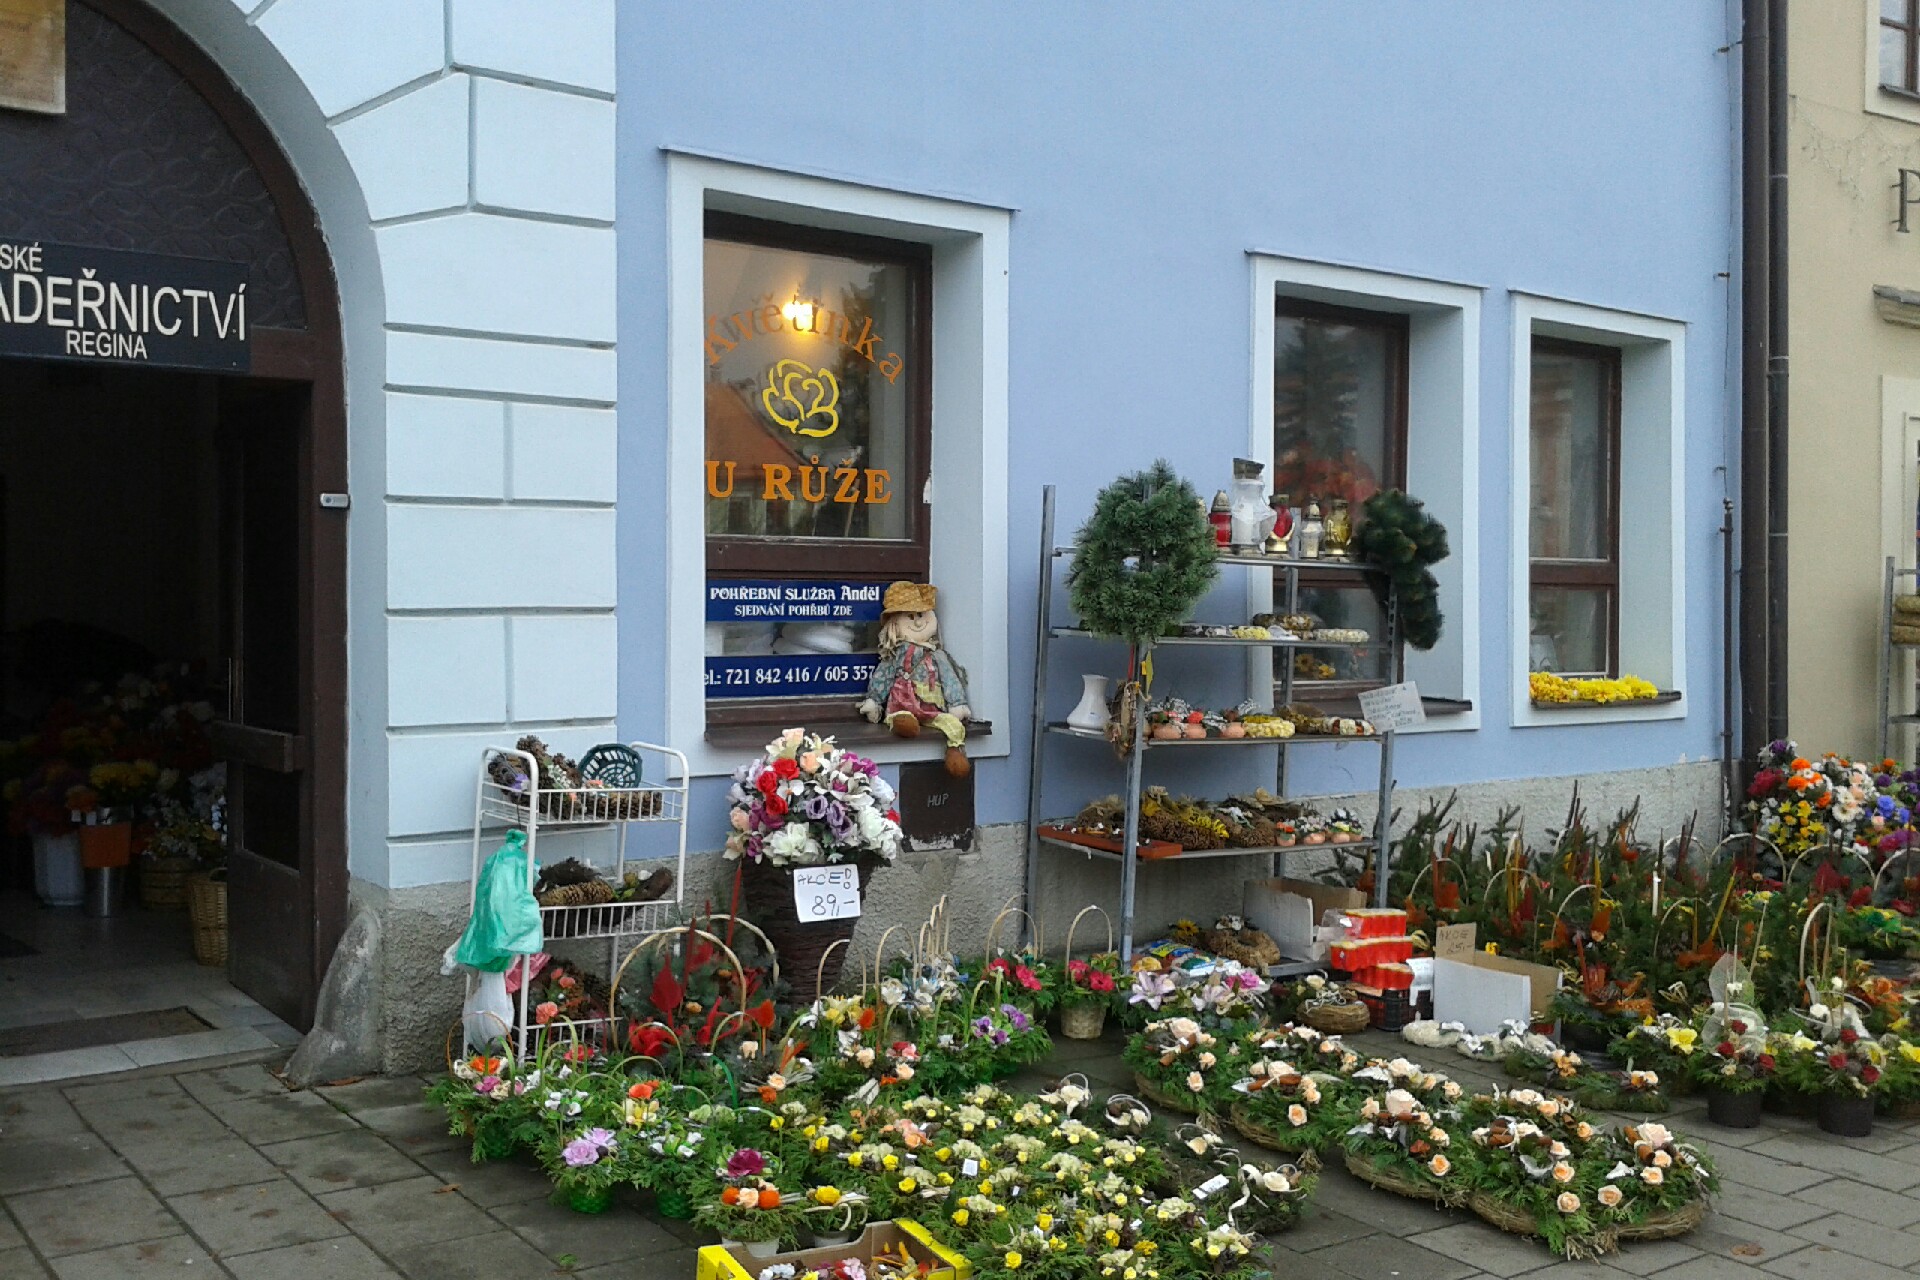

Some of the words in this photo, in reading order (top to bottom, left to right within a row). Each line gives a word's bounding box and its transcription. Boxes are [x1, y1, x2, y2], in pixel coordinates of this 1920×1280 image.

[66, 329, 148, 360] REGINA
[705, 461, 737, 498] U
[762, 455, 892, 504] RŮŽE
[710, 585, 782, 600] POHŘEBNÍ
[785, 585, 836, 601] SLUŽBA
[841, 584, 880, 601] Anděl
[734, 602, 786, 617] SJEDNÁNÍ
[788, 603, 831, 617] POHŘBŮ
[833, 605, 853, 617] ZDE
[725, 668, 750, 685] 721
[755, 667, 782, 685] 842
[785, 666, 810, 683] 416
[824, 665, 849, 682] 605
